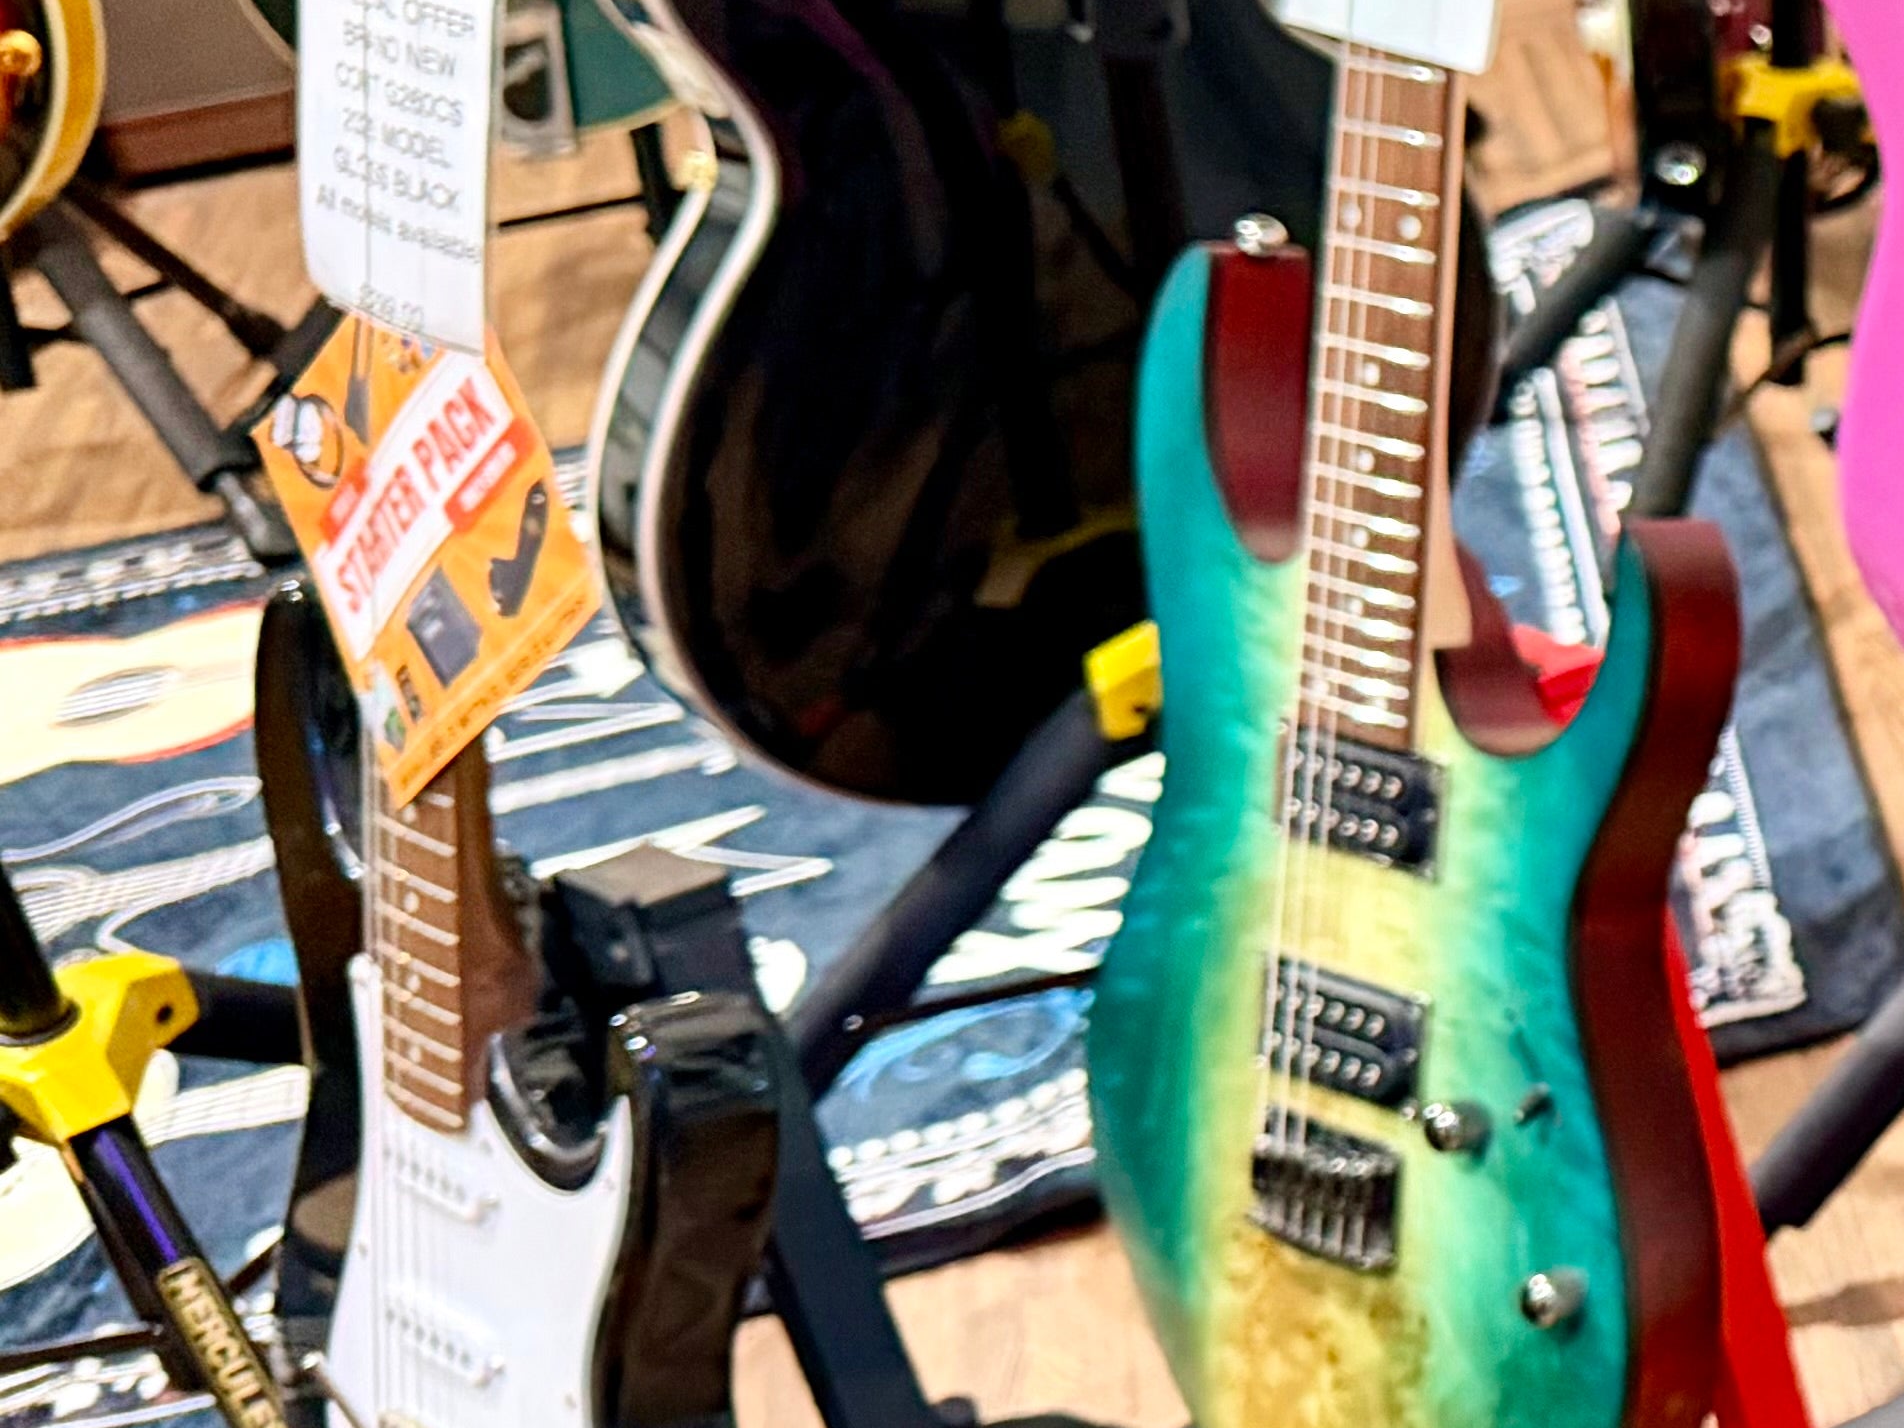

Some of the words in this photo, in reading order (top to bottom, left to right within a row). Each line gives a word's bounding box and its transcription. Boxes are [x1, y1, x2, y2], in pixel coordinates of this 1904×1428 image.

[405, 41, 457, 76] NEW
[336, 464, 426, 614] STARTER
[411, 375, 498, 493] PACK
